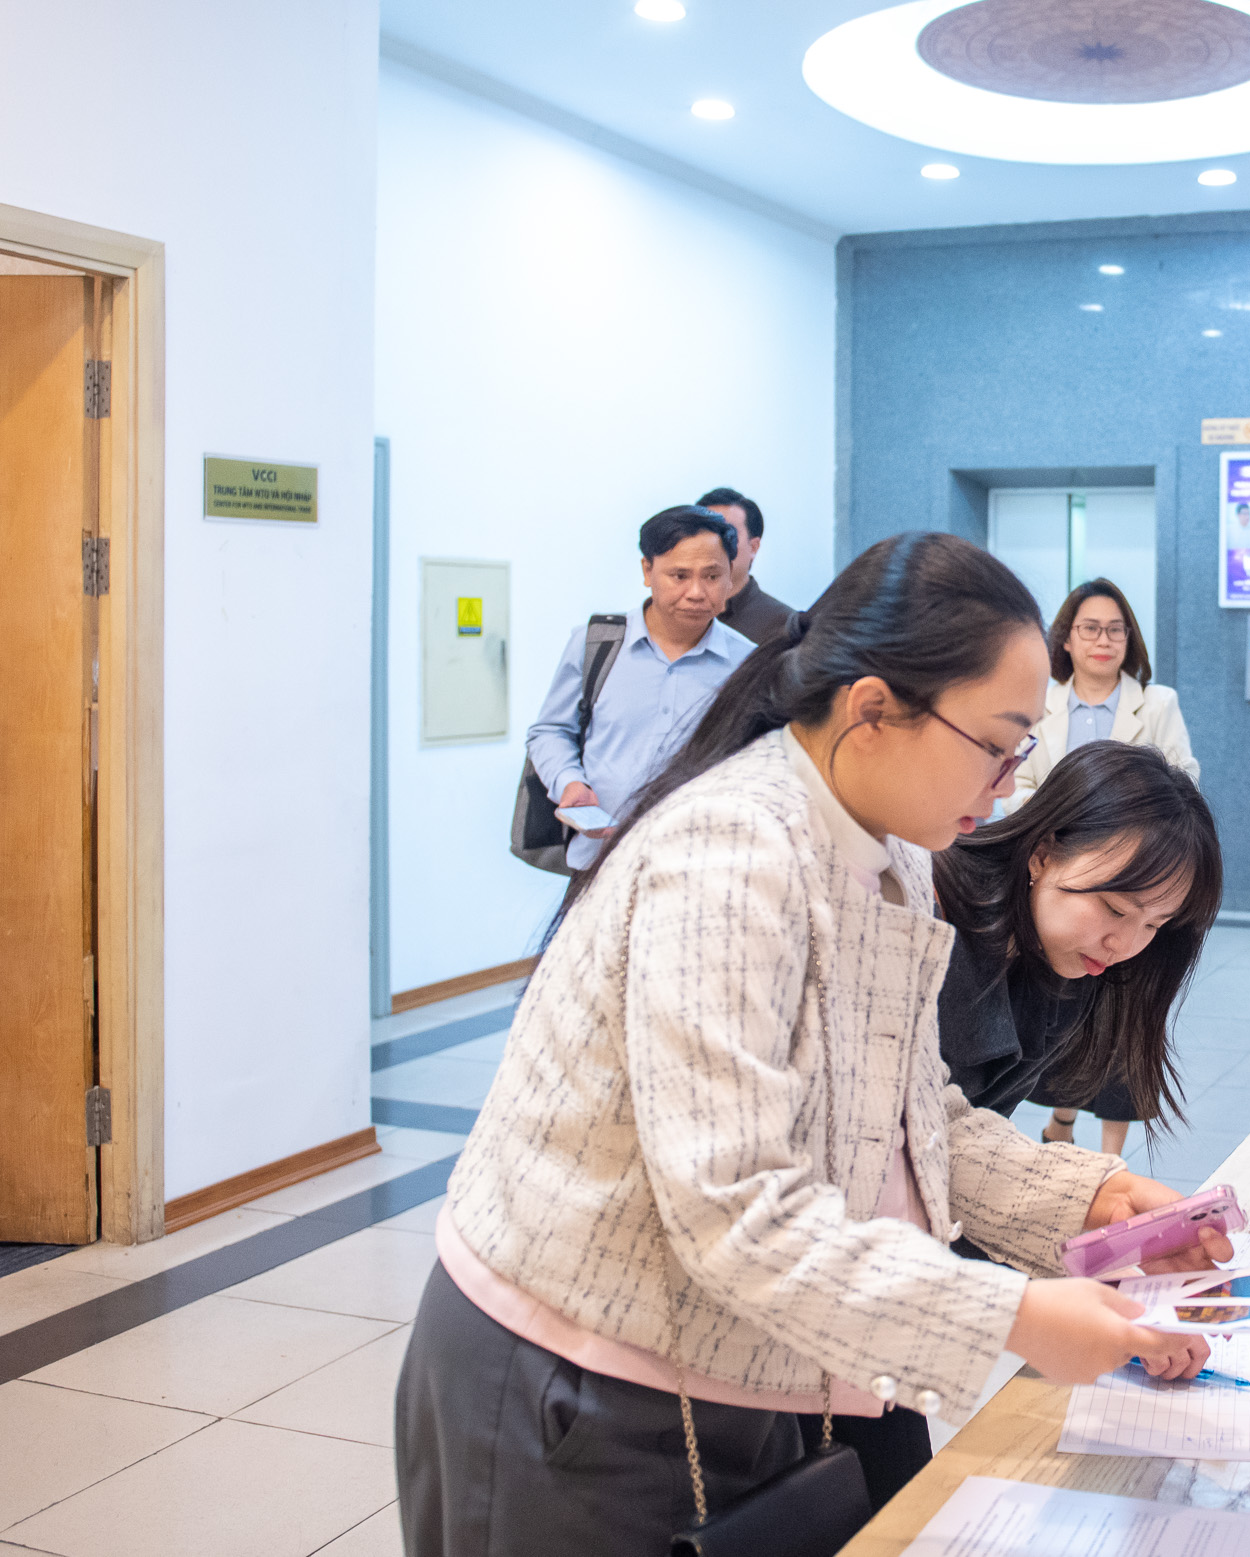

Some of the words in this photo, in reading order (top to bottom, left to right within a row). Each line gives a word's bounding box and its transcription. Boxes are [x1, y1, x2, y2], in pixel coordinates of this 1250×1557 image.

[251, 468, 277, 483] VCCI
[214, 484, 236, 497] TRUNG
[238, 486, 253, 498] TÂM
